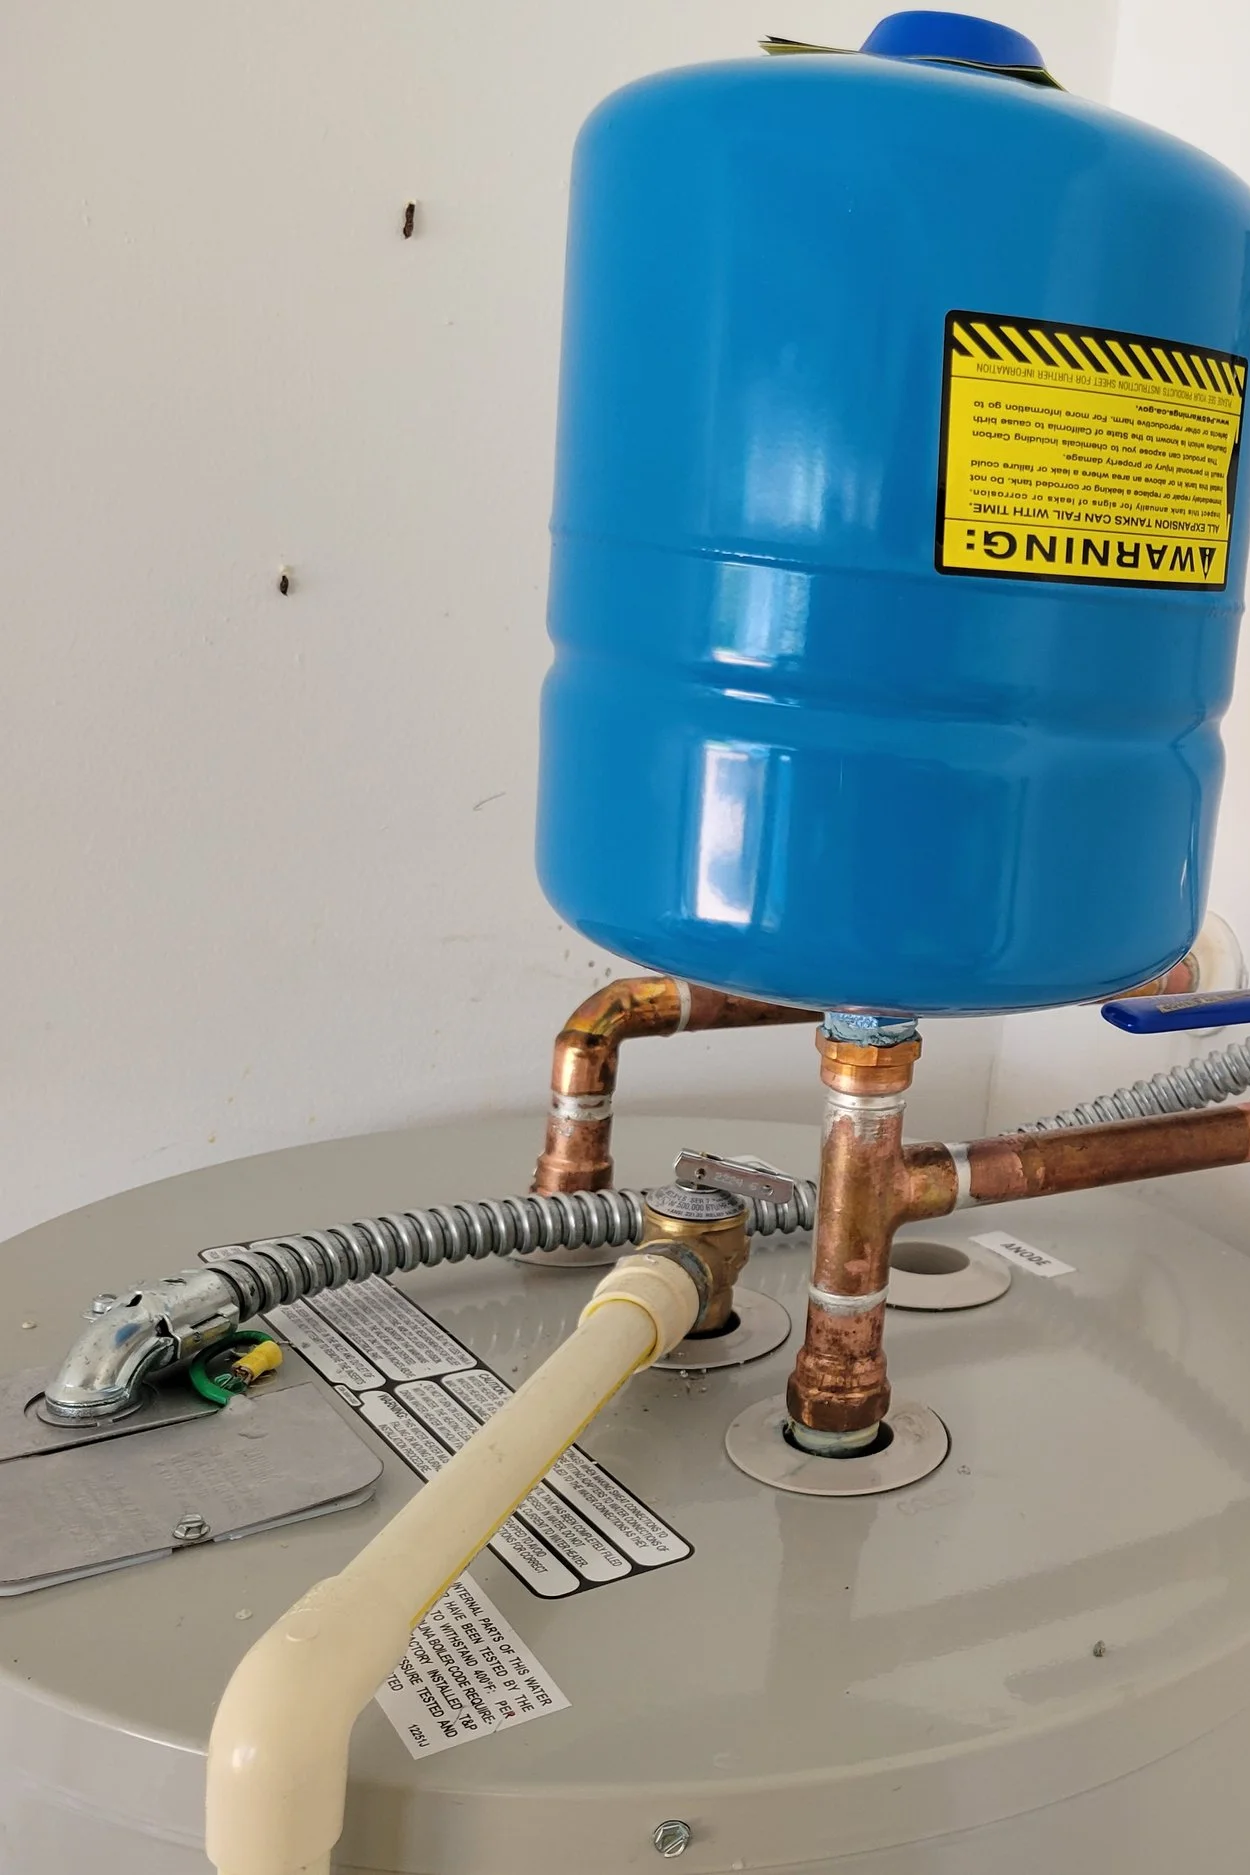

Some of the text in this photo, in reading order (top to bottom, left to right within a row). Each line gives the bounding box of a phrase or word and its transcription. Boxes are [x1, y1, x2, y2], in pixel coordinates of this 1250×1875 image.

[976, 363, 1035, 378] INFORMATION
[1037, 369, 1074, 384] FURTHER
[1075, 375, 1092, 386] FOR
[1093, 377, 1117, 389] SHEET
[1118, 380, 1162, 395] INSTRUCTION
[1162, 386, 1193, 401] PRODUCTS
[973, 400, 985, 409] to
[988, 401, 1002, 409] go
[1207, 394, 1217, 406] SEE
[1005, 403, 1062, 417] information
[1064, 410, 1090, 420] more
[972, 415, 998, 425] birth
[1092, 414, 1108, 423] For
[1135, 405, 1230, 426] www.P65Warnings.ca.gov.
[1000, 418, 1032, 428] cause
[1034, 421, 1045, 430] to
[1110, 416, 1135, 426] harm.
[1136, 419, 1183, 432] reproductive
[1047, 423, 1093, 436] California
[1094, 428, 1104, 436] of
[1184, 426, 1201, 435] other
[972, 430, 1011, 442] Carbon
[1013, 432, 1059, 447] including
[1106, 430, 1129, 440] State
[1130, 432, 1144, 442] the
[1145, 434, 1154, 443] to
[1061, 439, 1108, 451] chemicals
[1155, 436, 1179, 447] known
[1180, 439, 1187, 447] is
[1187, 440, 1205, 449] which
[1110, 444, 1120, 453] to
[1121, 445, 1137, 454] you
[1138, 448, 1167, 457] expose
[1063, 453, 1104, 465] damage.
[1105, 457, 1143, 469] property
[1182, 453, 1207, 463] product
[1207, 457, 1218, 466] This
[970, 459, 1000, 468] could
[1002, 462, 1034, 473] failure
[1154, 463, 1175, 473] injury
[1050, 467, 1071, 477] leak
[1081, 470, 1110, 480] where
[1175, 466, 1204, 476] personal
[1204, 470, 1210, 478] in
[969, 474, 988, 482] not
[990, 476, 1005, 485] Do
[1007, 477, 1033, 487] tank.
[1111, 473, 1131, 481] area
[1132, 475, 1143, 483] an
[1144, 477, 1167, 486] above
[1035, 480, 1080, 490] corroded
[1081, 484, 1092, 492] or
[1167, 479, 1176, 487] or
[1176, 480, 1183, 489] in
[1184, 481, 1198, 490] tank
[1198, 483, 1209, 491] this
[1093, 484, 1125, 496] leaking
[1133, 489, 1162, 499] replace
[1171, 494, 1191, 502] repair
[1191, 494, 1222, 506] Immediately
[969, 489, 1221, 519] Inspect this tank annually for signs of leaks or corrosion.
[969, 502, 1220, 534] ALL EXPANSION TANKS CAN FAIL WITH TIME.
[966, 529, 1195, 573] WARNING:
[1000, 1243, 1051, 1266] ANODE
[377, 1394, 408, 1420] WARNING:
[579, 1464, 597, 1477] WHEN
[592, 1474, 615, 1491] MAKING
[608, 1489, 631, 1504] SWEAT
[623, 1502, 662, 1533] CONNECTIONS
[564, 1462, 586, 1479] FITTING
[581, 1477, 608, 1499] ADAPTERS
[608, 1502, 630, 1518] WATER
[623, 1516, 663, 1547] CONNECTIONS
[569, 1480, 585, 1491] THE
[577, 1488, 599, 1504] WATER
[592, 1502, 630, 1532] CONNECTIONS
[630, 1535, 649, 1549] THEY
[541, 1494, 623, 1567] TANK HAS BEEN COMPLETELY FILLED
[568, 1536, 586, 1548] NOT
[510, 1541, 549, 1574] FOR CORRECT
[443, 1600, 535, 1713] HAVE BEEN TESTED BY THE
[429, 1609, 446, 1622] TO
[439, 1622, 479, 1667] WITHSTAND
[494, 1699, 516, 1720] PER
[478, 1617, 505, 1643] PARTS
[498, 1643, 516, 1655] OF
[508, 1656, 530, 1676] THIS
[523, 1676, 553, 1707] WATER
[428, 1638, 456, 1667] BOILER
[447, 1665, 472, 1689] CODE
[462, 1687, 496, 1725] REQUIRE-
[426, 1668, 465, 1710] INSTALLED
[456, 1713, 478, 1731] T&P
[416, 1686, 445, 1718] TESTED
[436, 1720, 458, 1738] AND
[407, 1724, 430, 1748] 12251J
